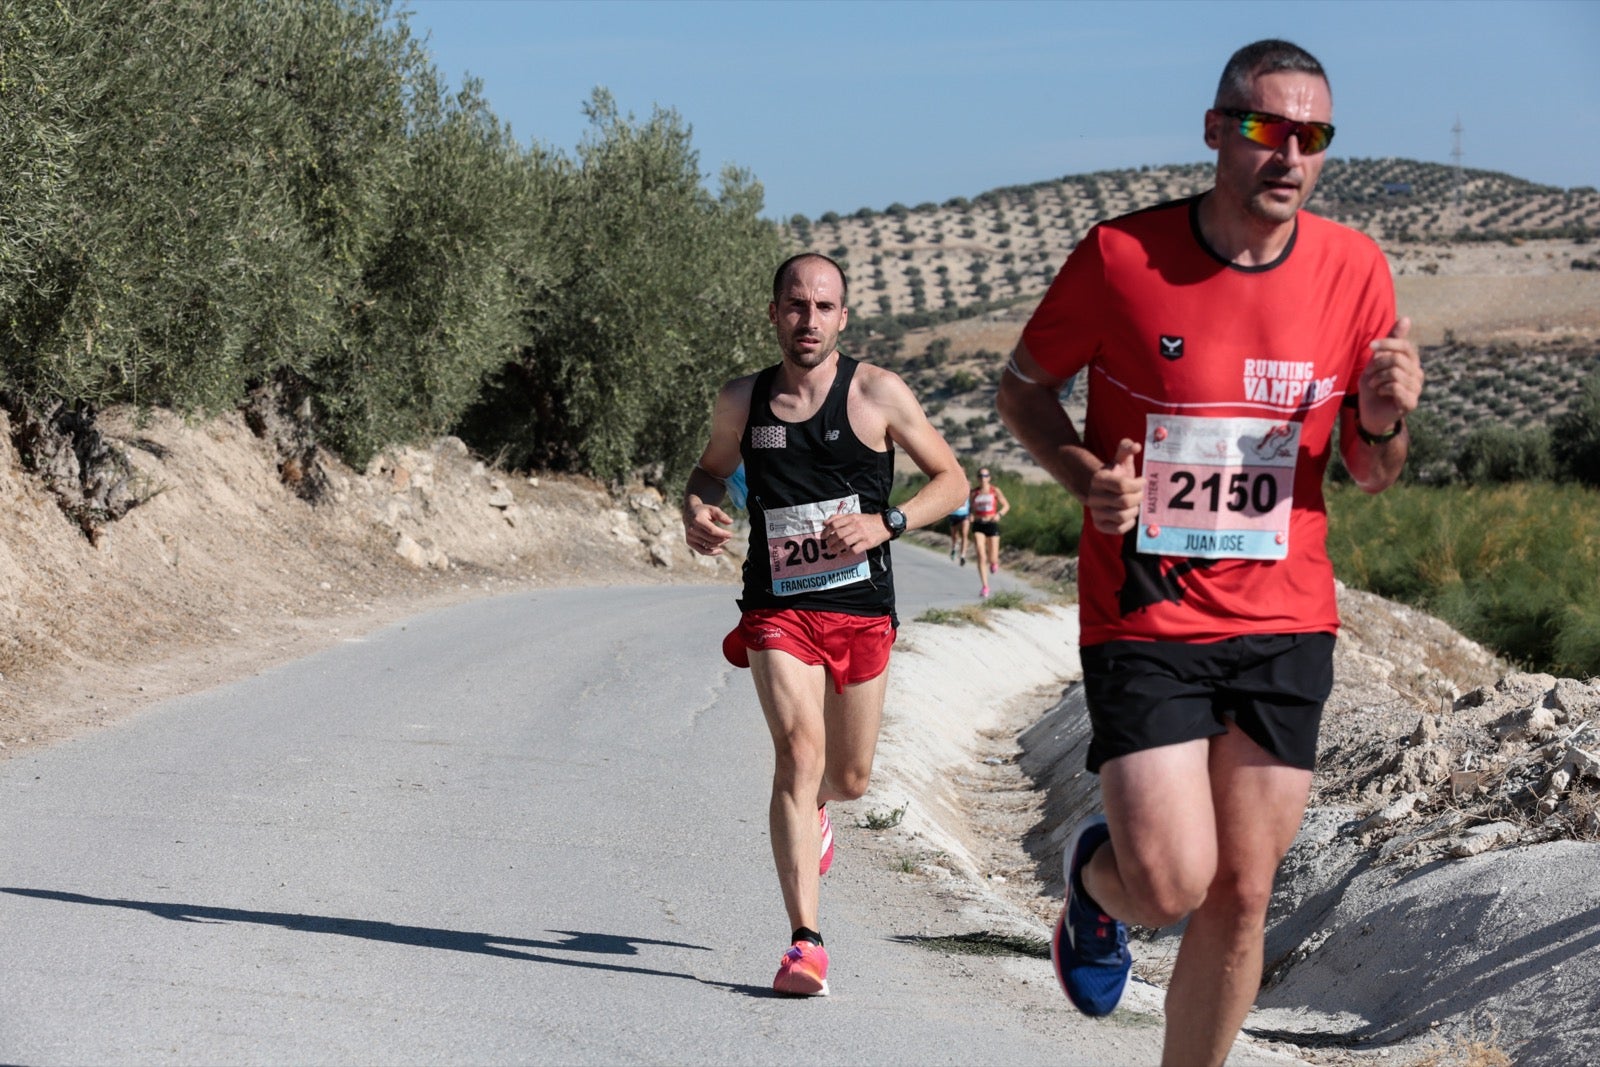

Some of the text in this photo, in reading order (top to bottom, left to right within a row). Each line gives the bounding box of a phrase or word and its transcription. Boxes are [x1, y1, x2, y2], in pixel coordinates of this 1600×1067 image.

[1243, 358, 1314, 380] RUNNING
[1148, 481, 1159, 514] MASTER
[1168, 471, 1277, 513] 2150
[784, 537, 848, 567] 205
[1184, 534, 1245, 551] JUAN JOSE
[780, 567, 861, 592] FRANCISCO MANUEL
